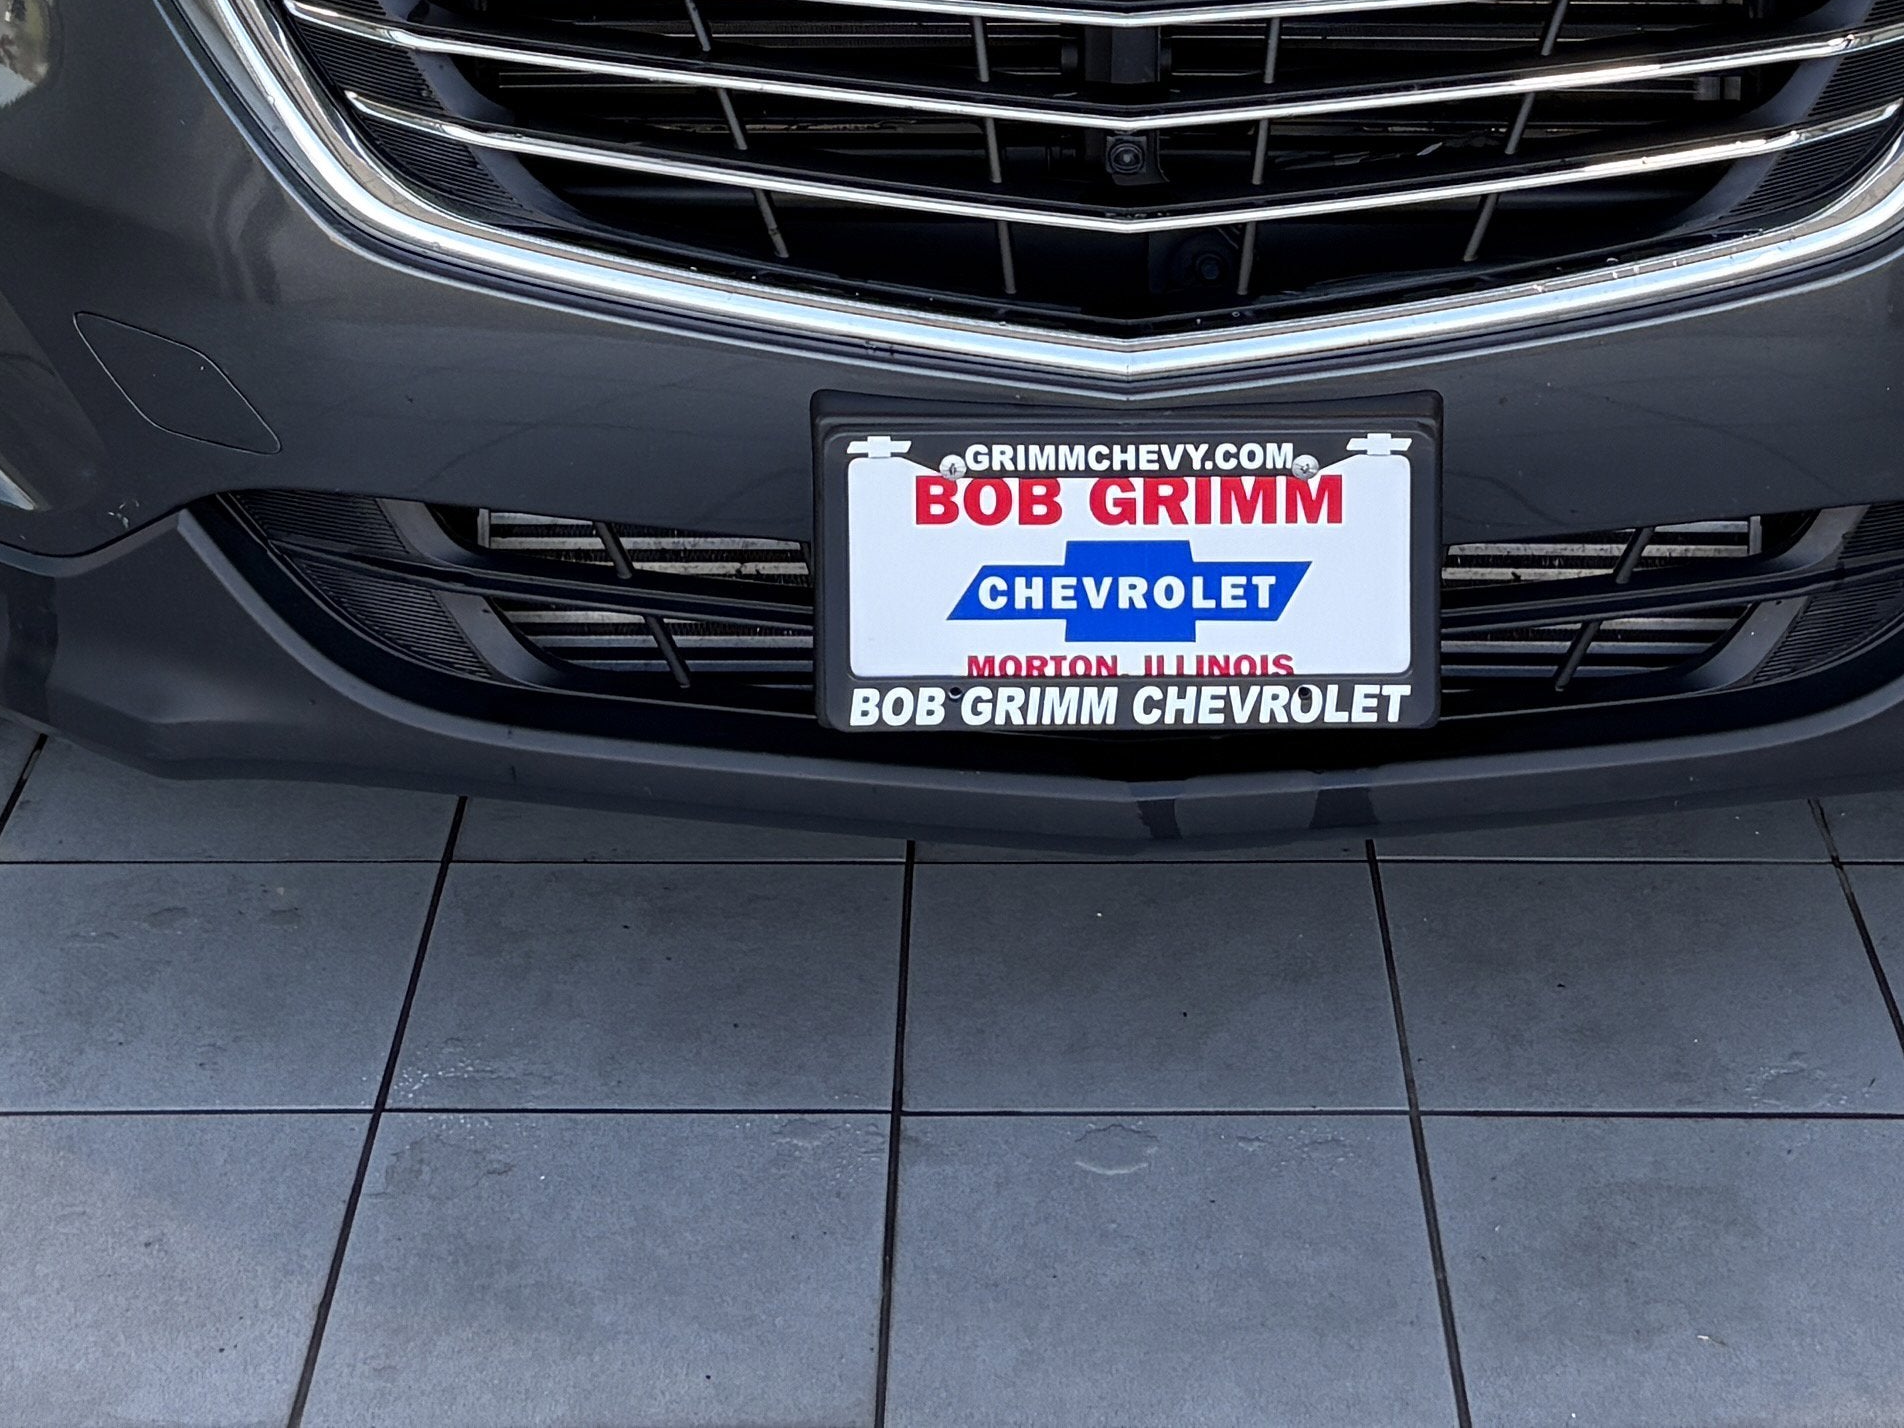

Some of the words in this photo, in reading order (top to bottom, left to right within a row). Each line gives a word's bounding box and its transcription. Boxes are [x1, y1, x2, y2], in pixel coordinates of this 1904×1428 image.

[964, 442, 1294, 471] GRIMMCHEVY.COM
[915, 474, 1063, 526] BOB
[1089, 474, 1343, 525] GRIMM
[977, 574, 1277, 610] CHEVROLET
[967, 654, 1127, 678] MORTON
[1144, 654, 1295, 678] ILLINOIS
[848, 685, 946, 726] BOB
[960, 684, 1117, 726] GRIMM
[1132, 683, 1412, 725] CHEVROLET
